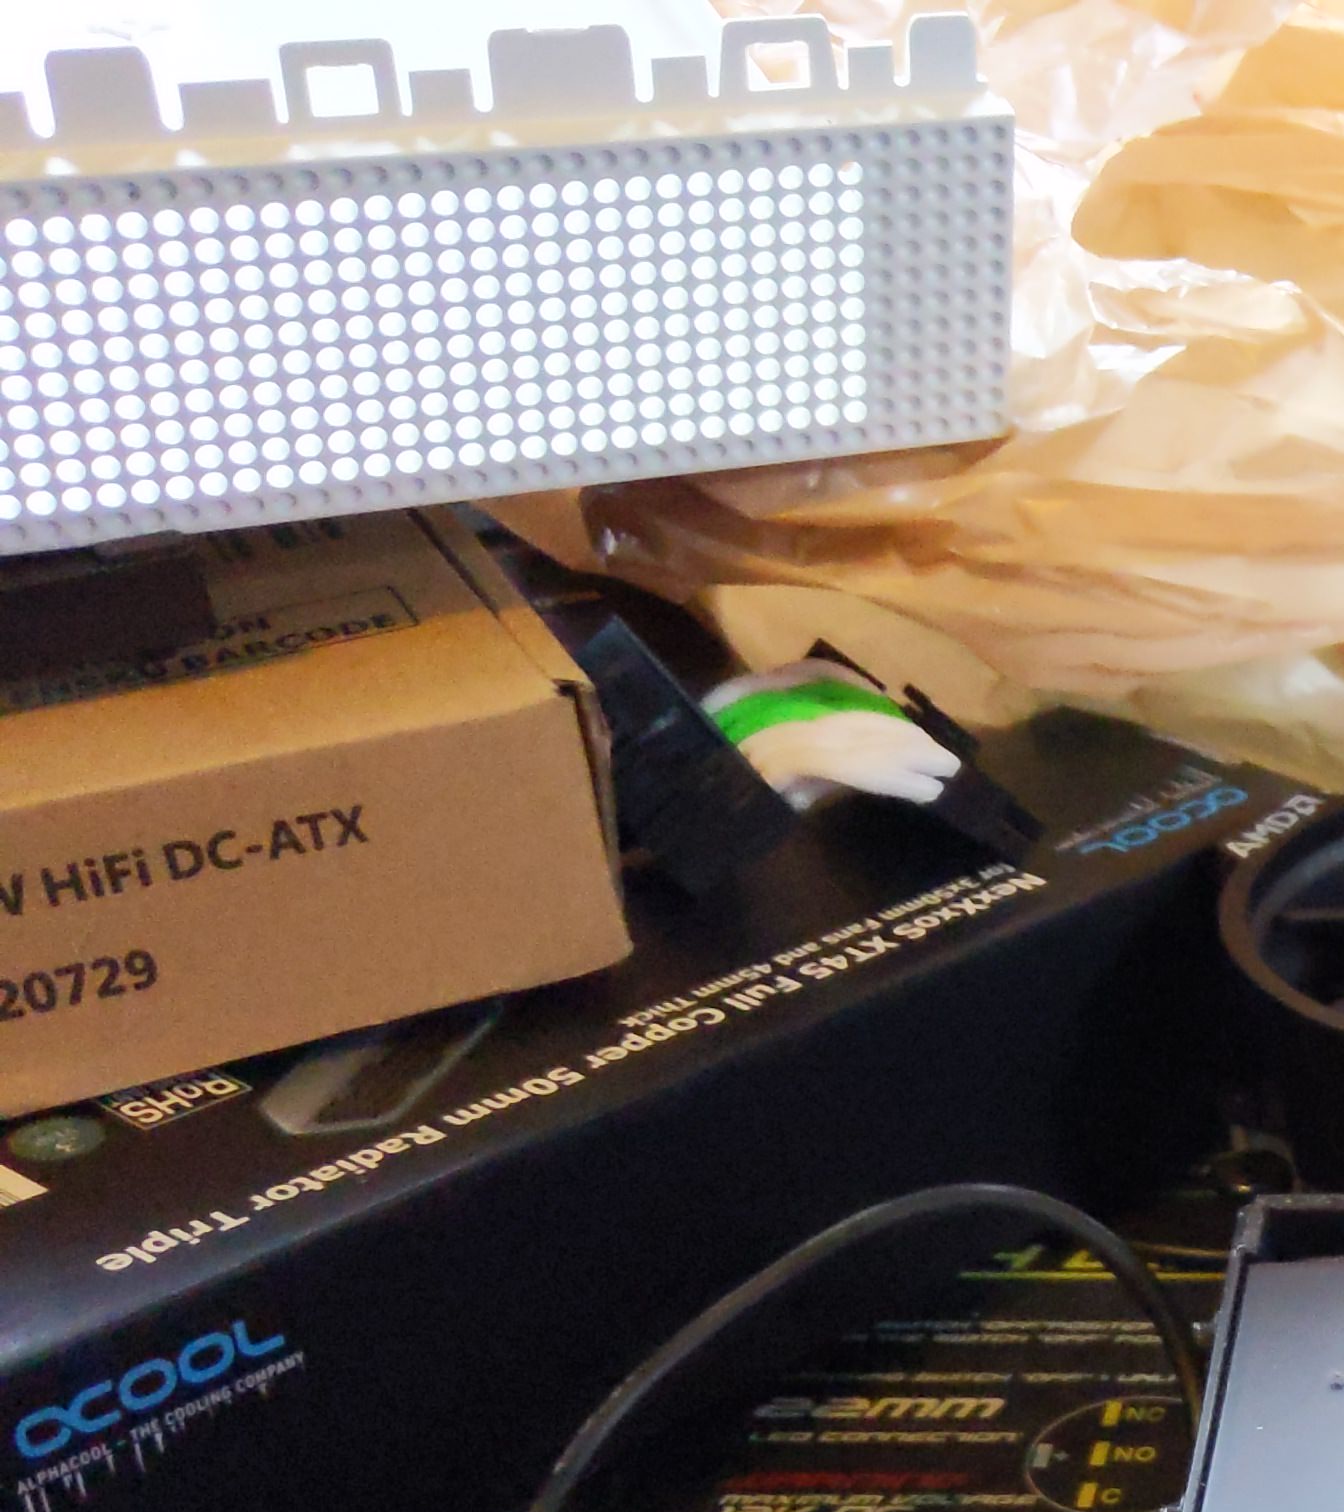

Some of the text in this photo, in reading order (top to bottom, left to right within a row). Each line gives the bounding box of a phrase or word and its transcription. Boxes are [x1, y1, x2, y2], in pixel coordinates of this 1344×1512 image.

[183, 613, 396, 671] BARCODE
[41, 848, 153, 907] HiFi
[163, 805, 369, 881] DC-ATX
[800, 936, 901, 981] XT45
[619, 996, 700, 1028] Thick
[724, 974, 804, 1013] Full
[586, 1007, 726, 1070] Copper
[120, 1077, 240, 1124] RoHS
[444, 1064, 586, 1128] 50mm
[251, 1124, 446, 1212] Radiator
[96, 1210, 250, 1272] Triple
[17, 1443, 112, 1493] ALPHACOOL
[164, 1384, 232, 1427] COOLING
[235, 1350, 305, 1394] COMPANY
[1126, 1405, 1165, 1421] NC
[1113, 1446, 1157, 1462] NO
[1101, 1487, 1122, 1503] C
